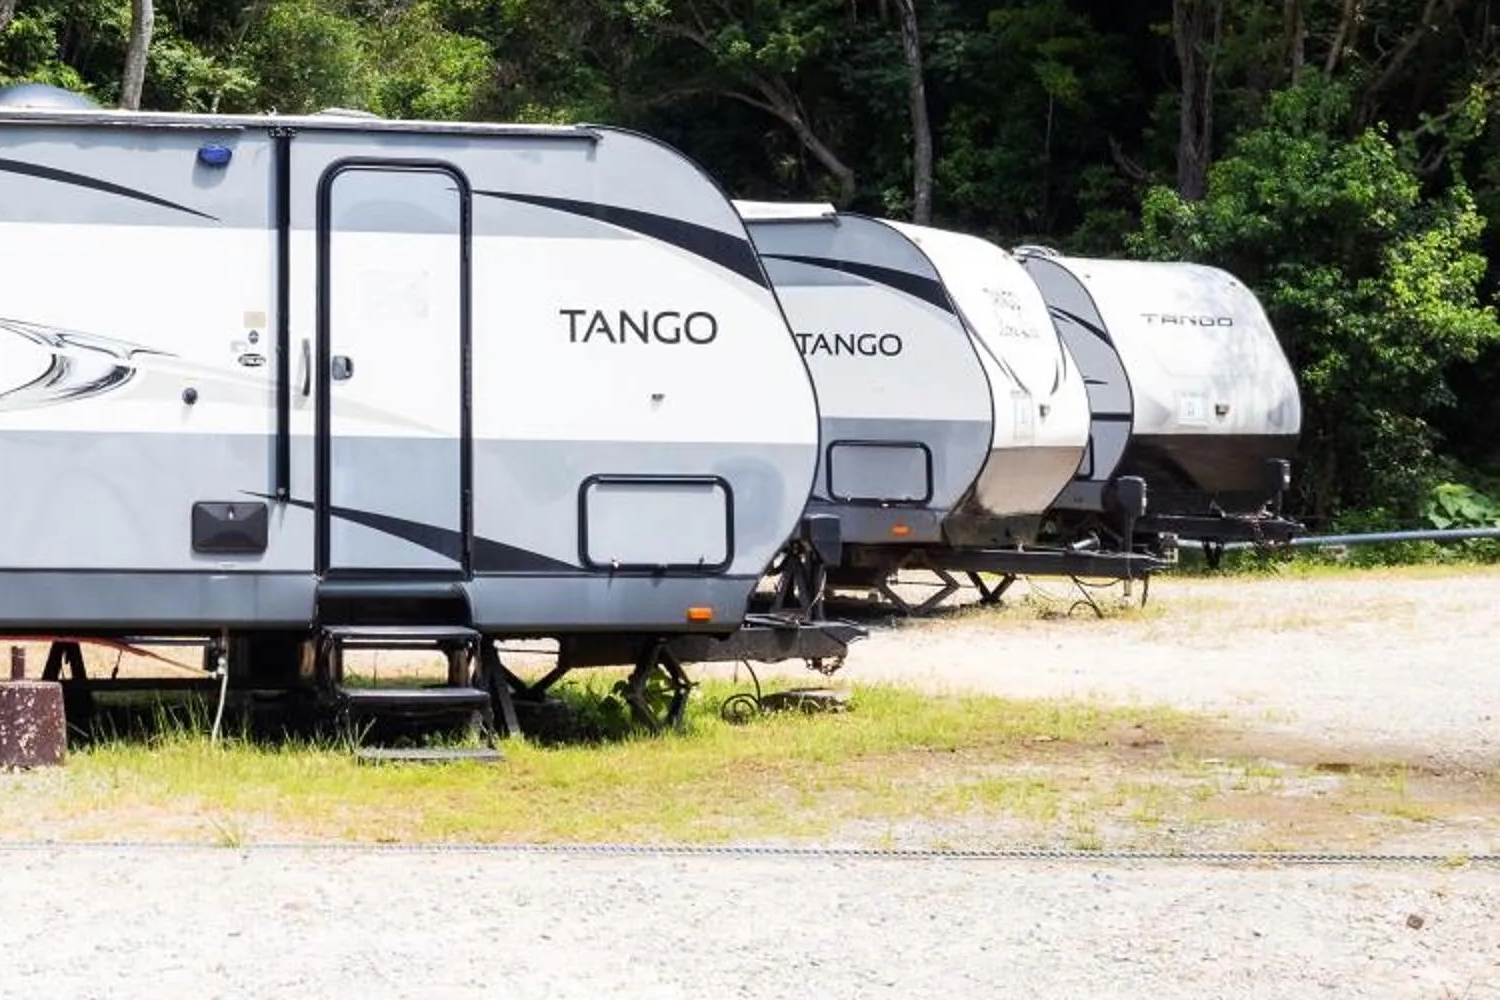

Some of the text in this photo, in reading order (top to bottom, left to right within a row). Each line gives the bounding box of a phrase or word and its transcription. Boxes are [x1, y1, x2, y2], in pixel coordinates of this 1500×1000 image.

[559, 309, 718, 345] TANGO
[1141, 313, 1233, 326] TANGO
[795, 333, 903, 356] TANGO
